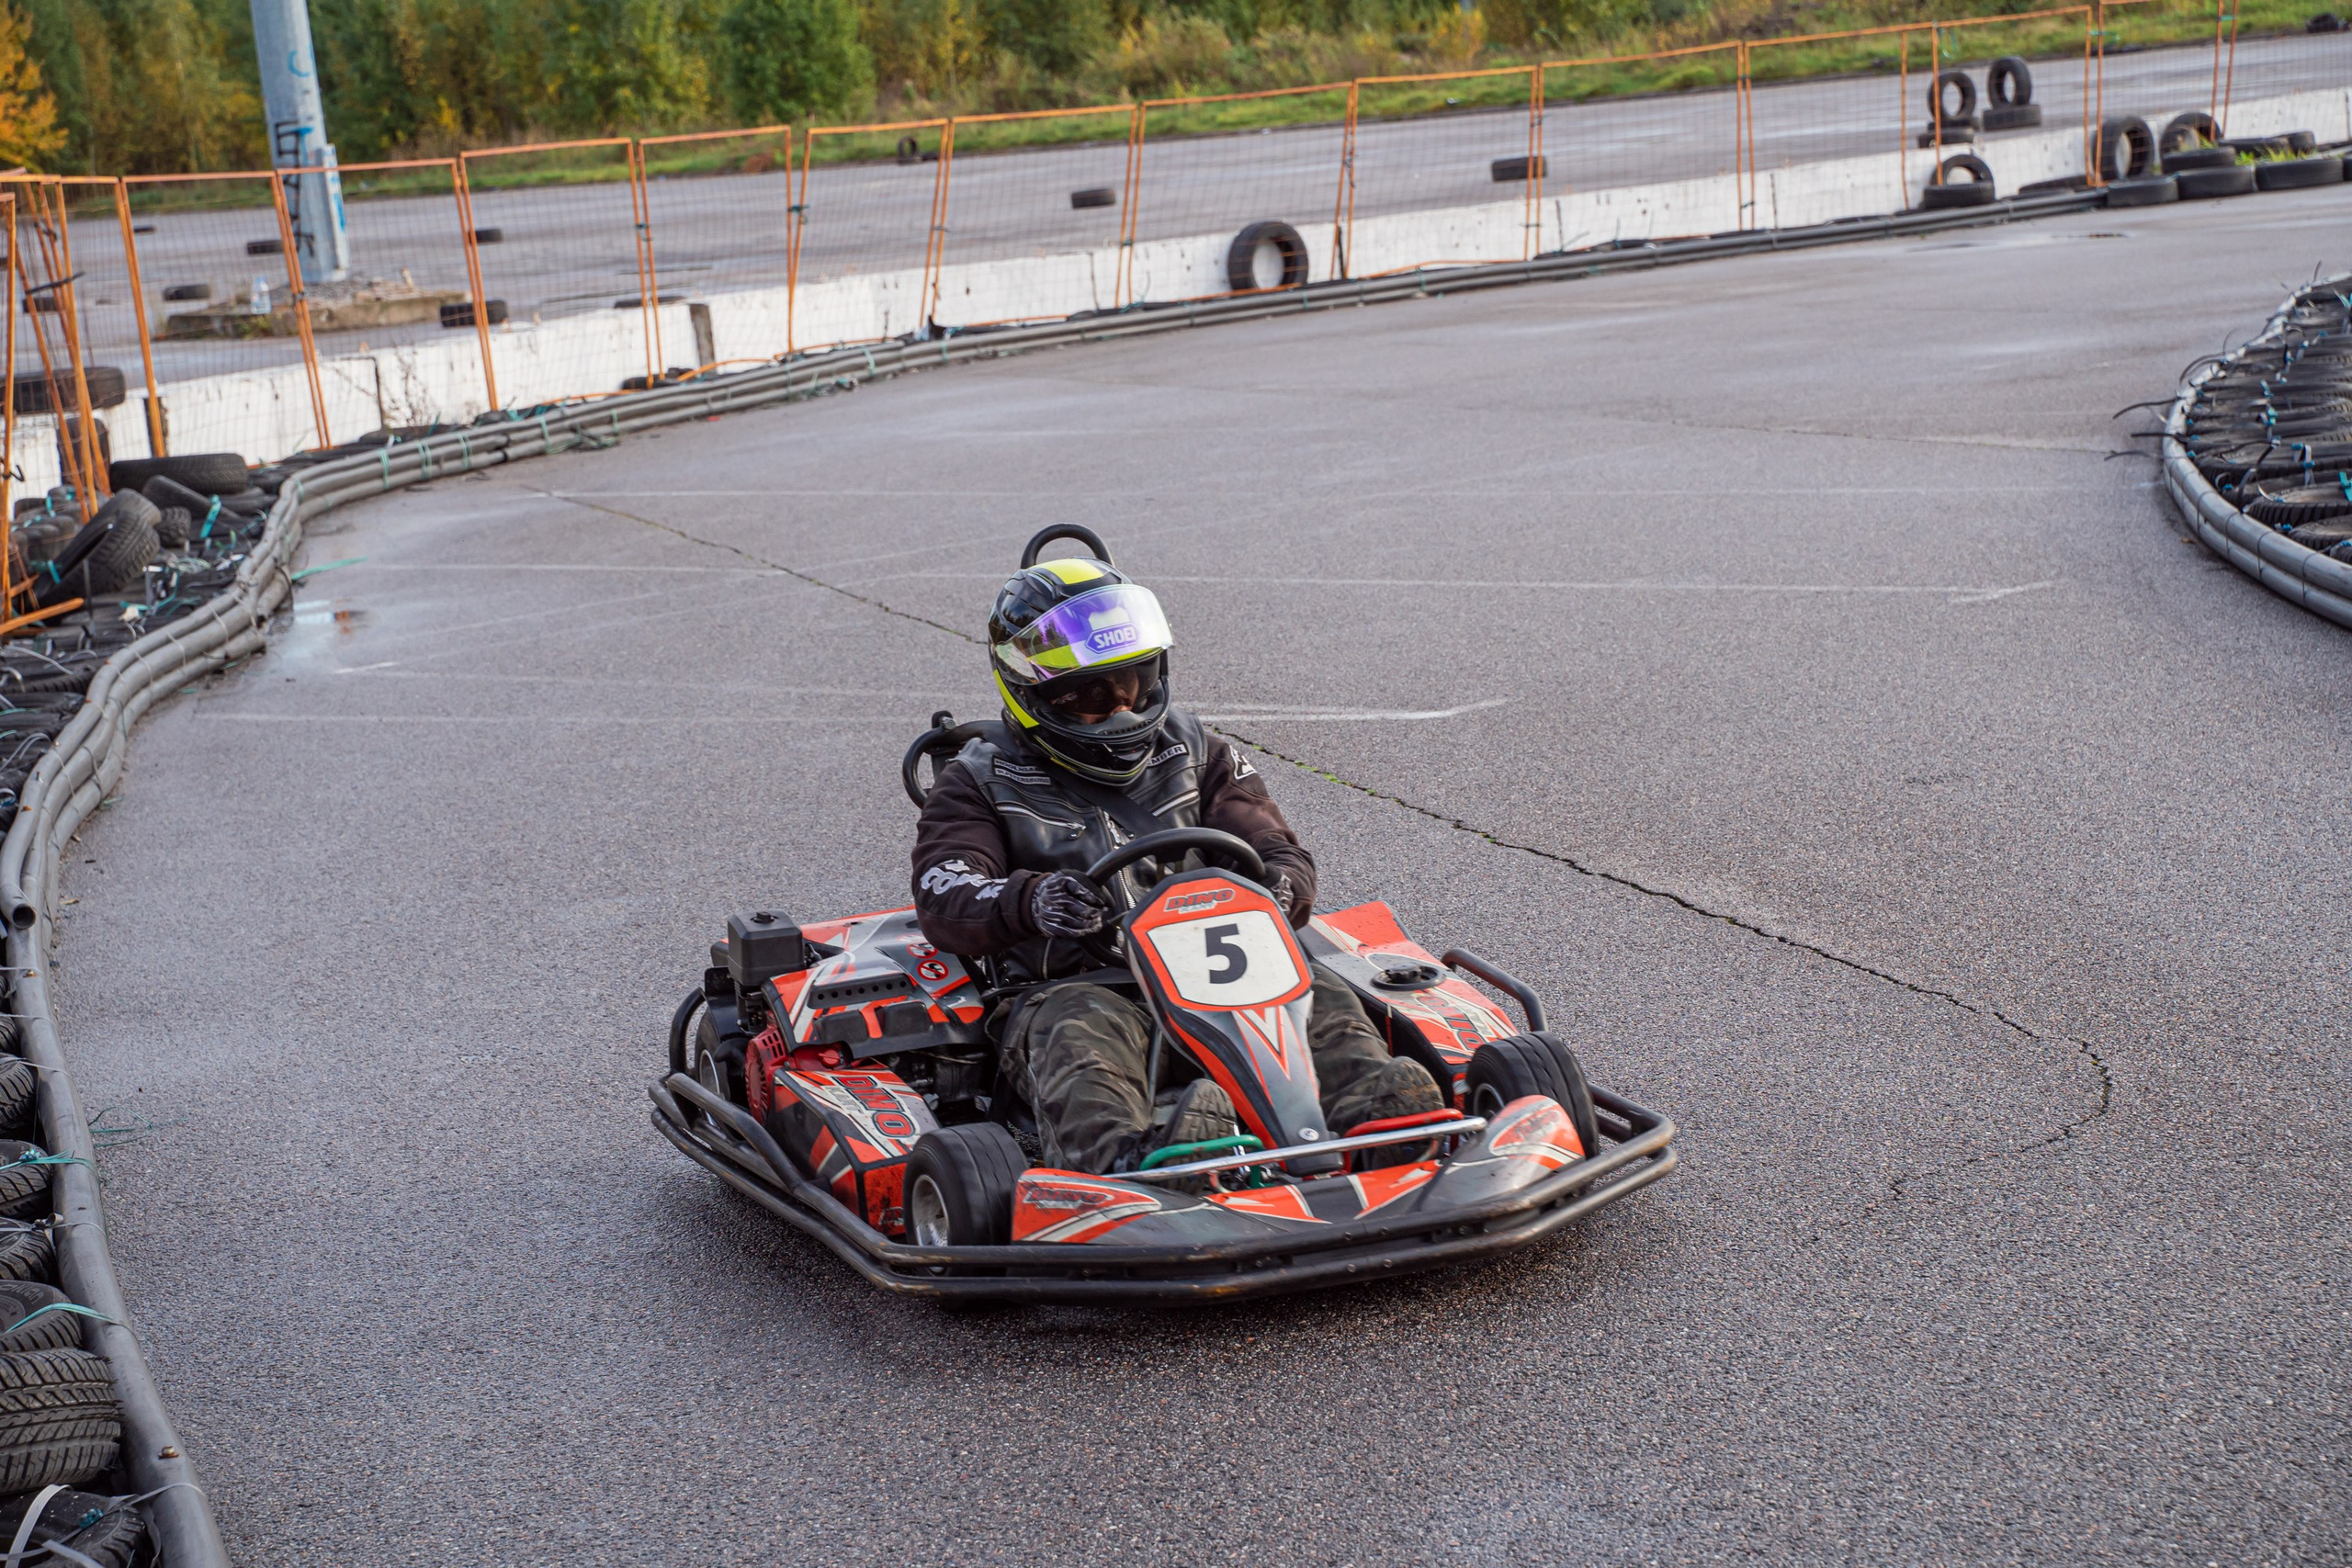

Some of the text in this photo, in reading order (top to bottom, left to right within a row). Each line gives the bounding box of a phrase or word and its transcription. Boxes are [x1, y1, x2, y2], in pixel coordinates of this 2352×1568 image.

[1093, 626, 1136, 649] SHOEI
[1165, 888, 1235, 910] DINO
[1204, 923, 1248, 985] 5
[1418, 996, 1488, 1052] DINO
[831, 1076, 916, 1139] DINO
[1025, 1187, 1108, 1204] DINO
